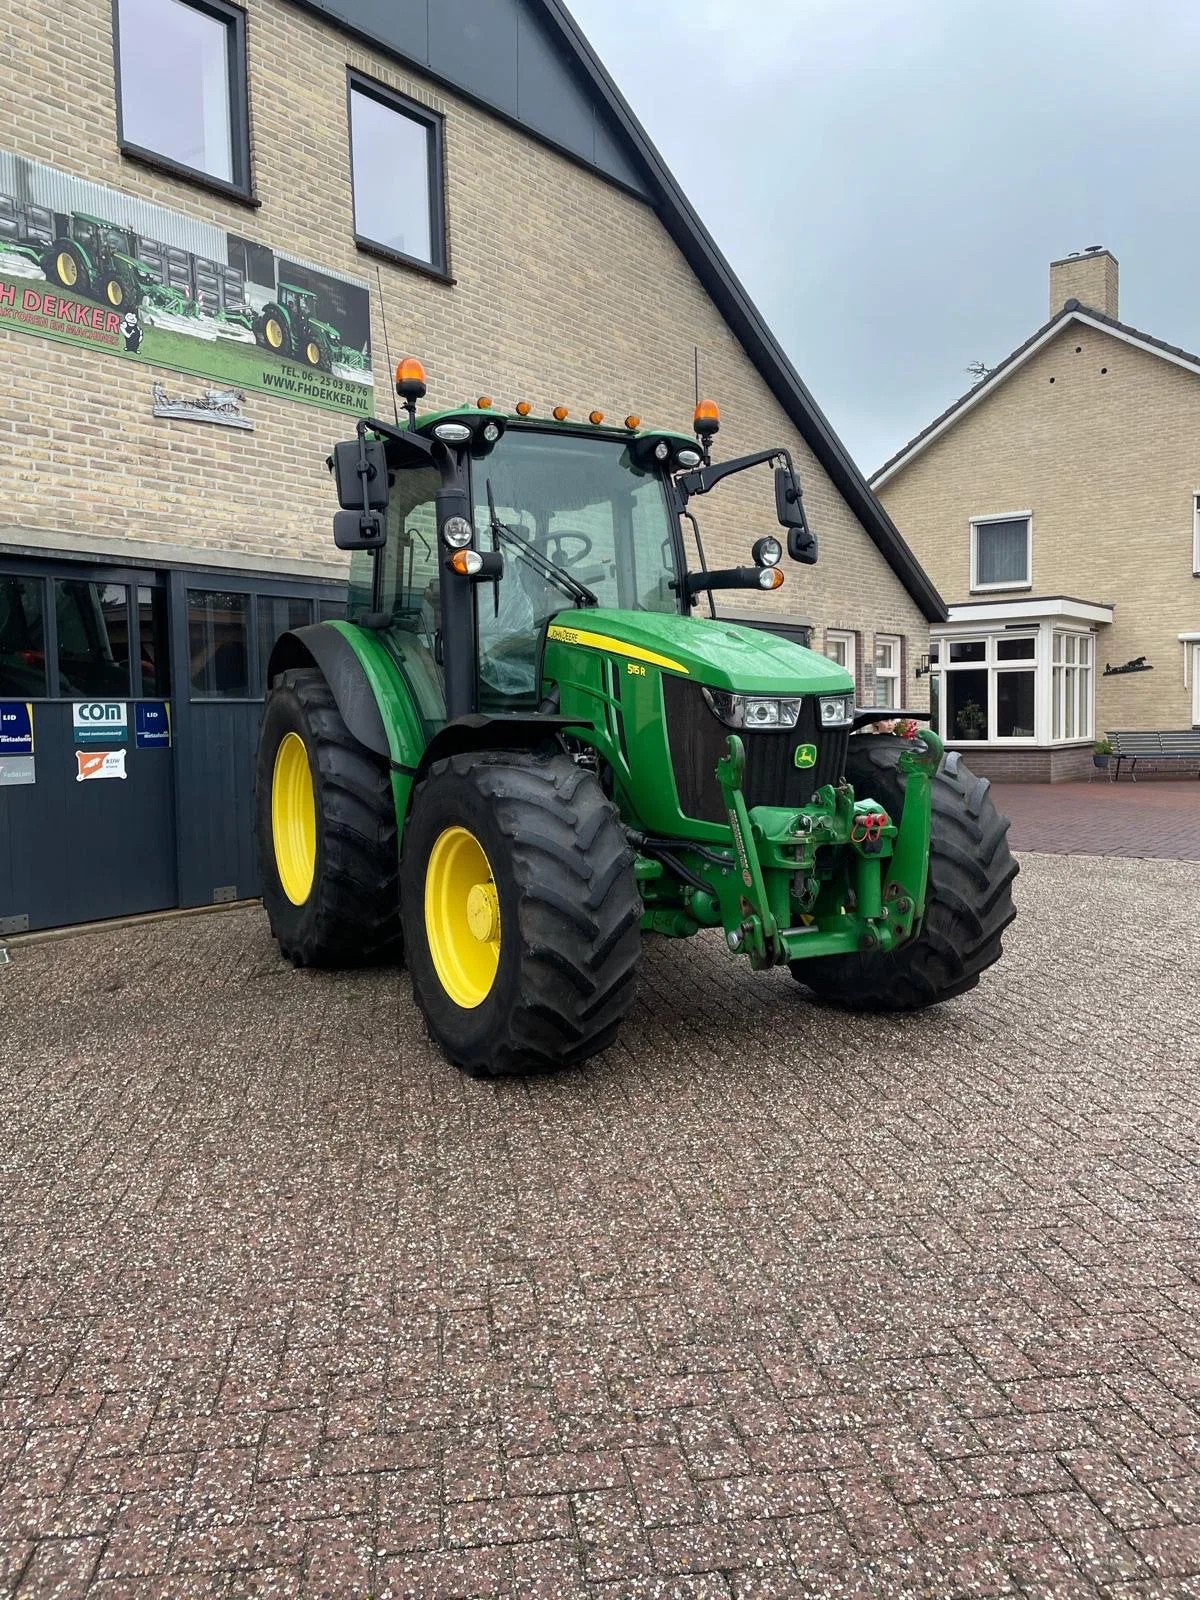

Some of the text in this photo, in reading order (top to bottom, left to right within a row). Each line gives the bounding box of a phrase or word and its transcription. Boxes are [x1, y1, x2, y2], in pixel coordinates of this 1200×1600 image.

[22, 289, 120, 334] DEKKER
[50, 319, 64, 332] EN
[66, 324, 119, 346] MACHINES
[262, 373, 369, 410] WWW.FHDEKKER.NL
[281, 365, 299, 378] TEL.
[302, 371, 313, 382] 06
[320, 376, 331, 386] 25
[333, 380, 343, 390] 03
[345, 384, 355, 394] 82
[357, 387, 368, 397] 76
[551, 630, 578, 642] JOHN DEERE
